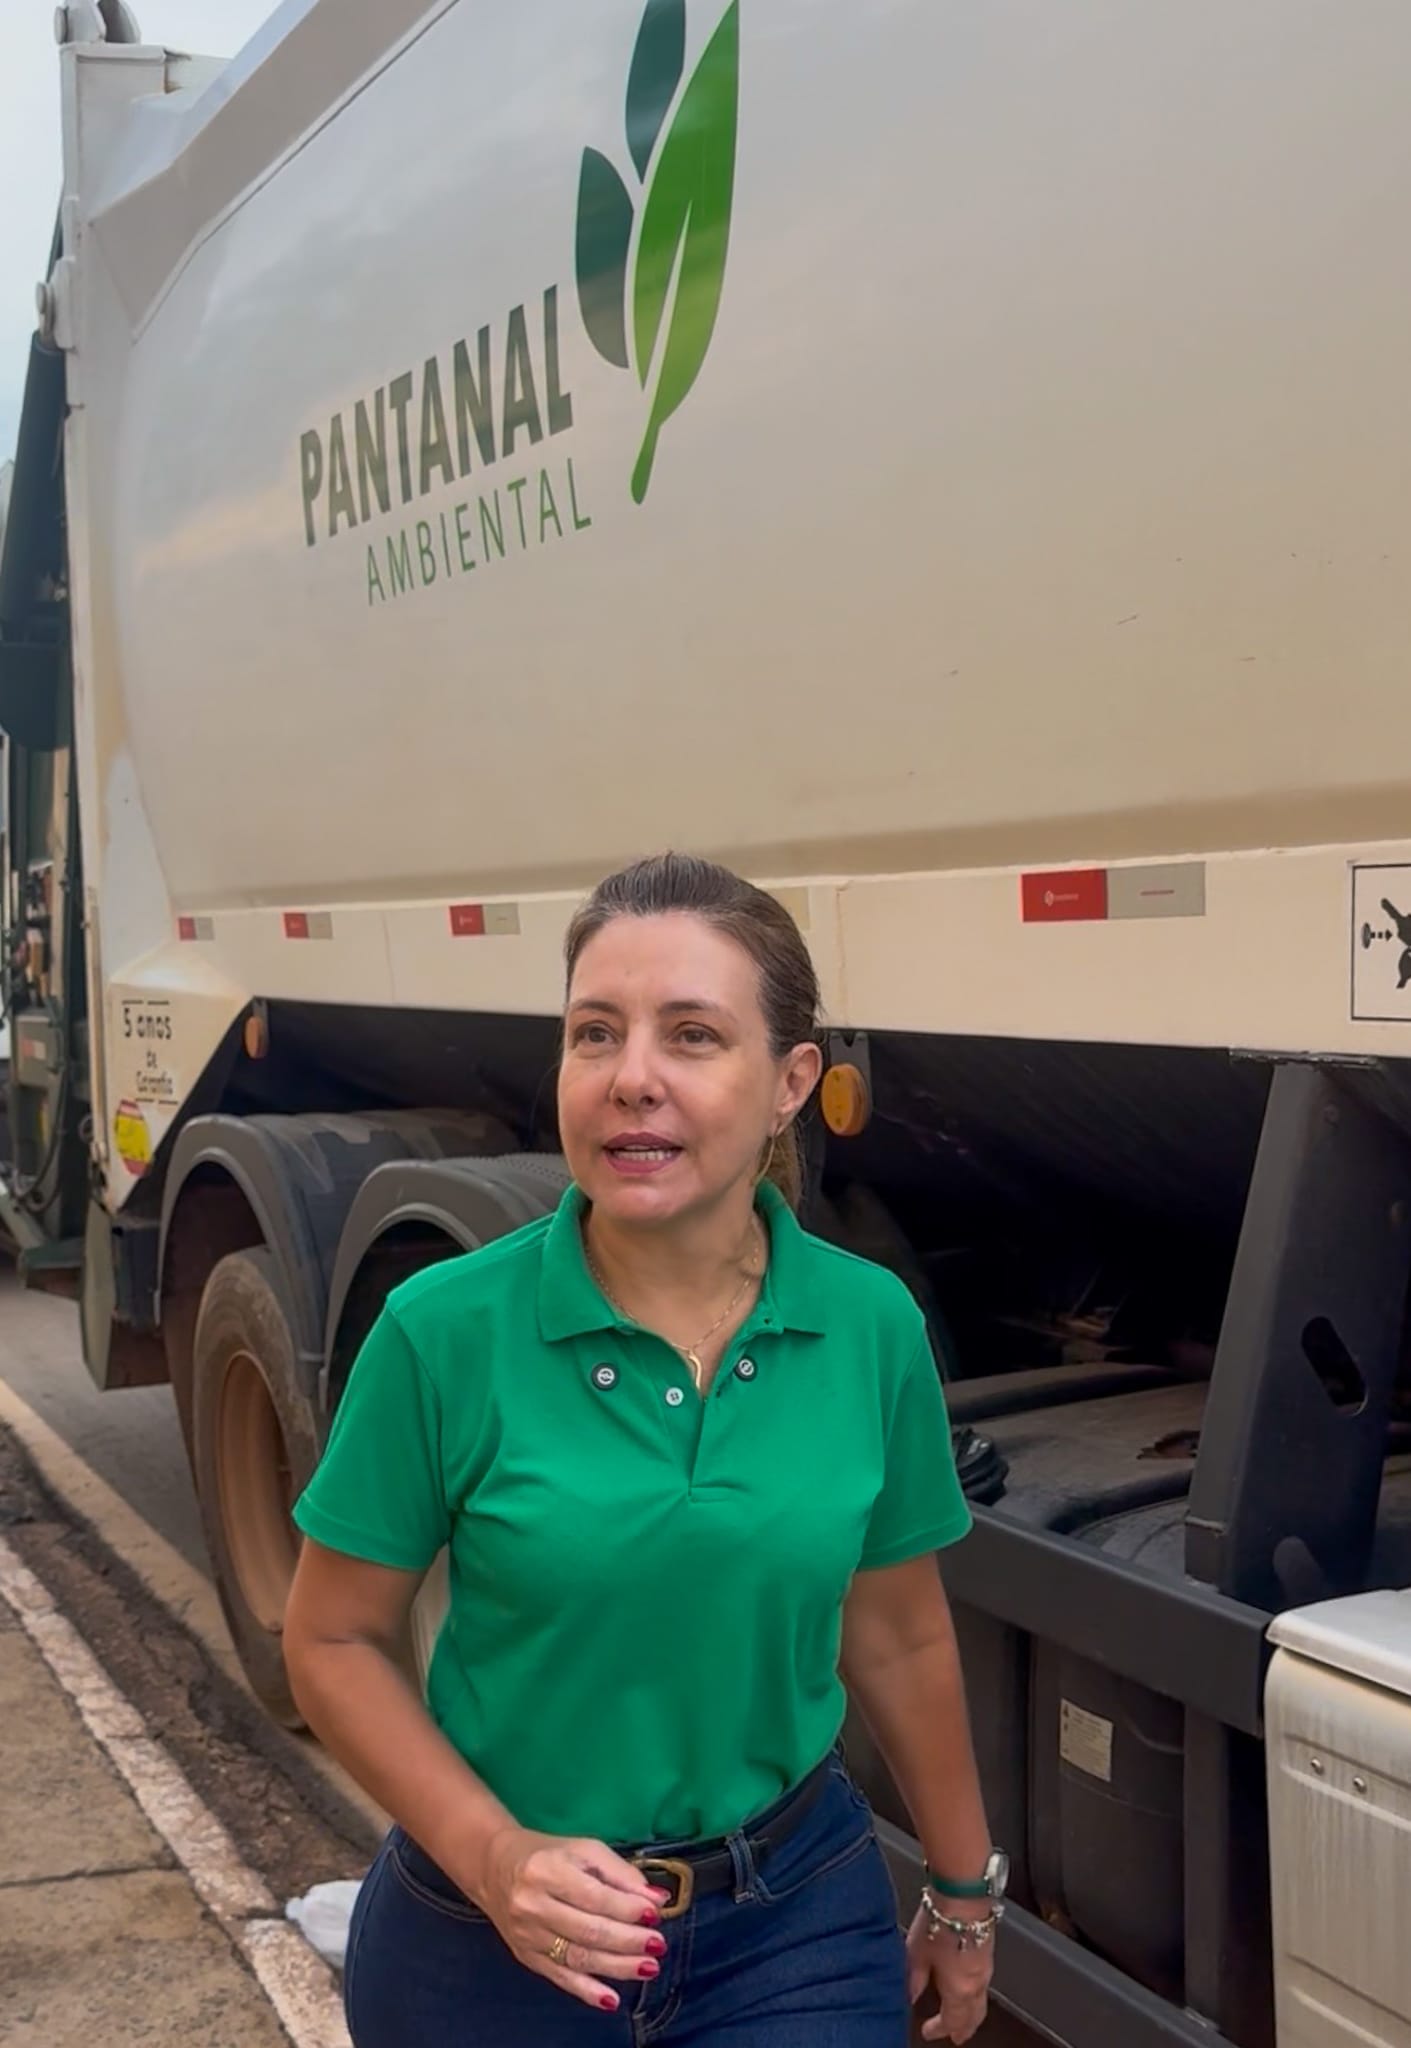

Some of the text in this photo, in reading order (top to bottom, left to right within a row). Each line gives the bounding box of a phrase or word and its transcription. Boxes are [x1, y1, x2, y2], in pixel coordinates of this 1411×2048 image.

[300, 284, 573, 548] PANTANAL
[367, 457, 592, 607] AMBIENTAL
[124, 1007, 132, 1038] 5
